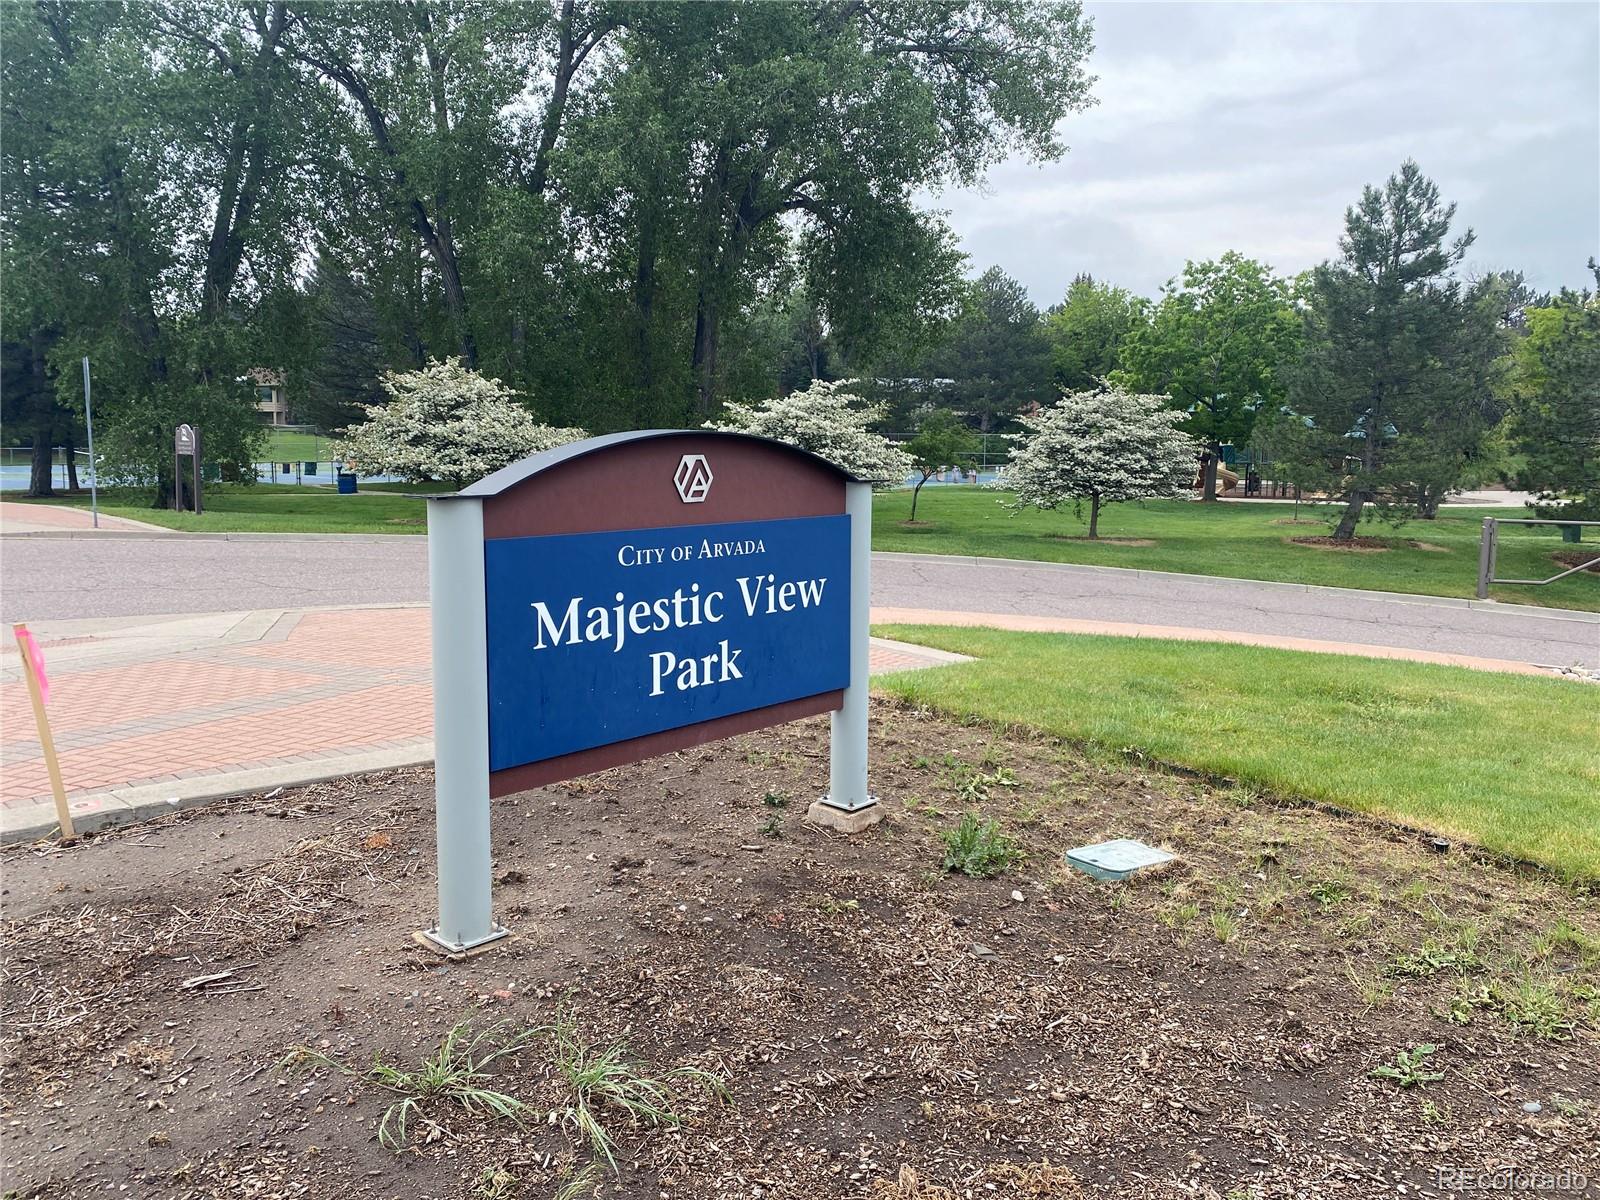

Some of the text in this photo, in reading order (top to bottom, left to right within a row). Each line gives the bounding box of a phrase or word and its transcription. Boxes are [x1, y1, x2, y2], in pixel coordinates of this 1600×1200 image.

[617, 545, 664, 567] CITY
[697, 539, 766, 560] ARVADA
[530, 573, 827, 653] Majestic View
[649, 639, 744, 697] Park
